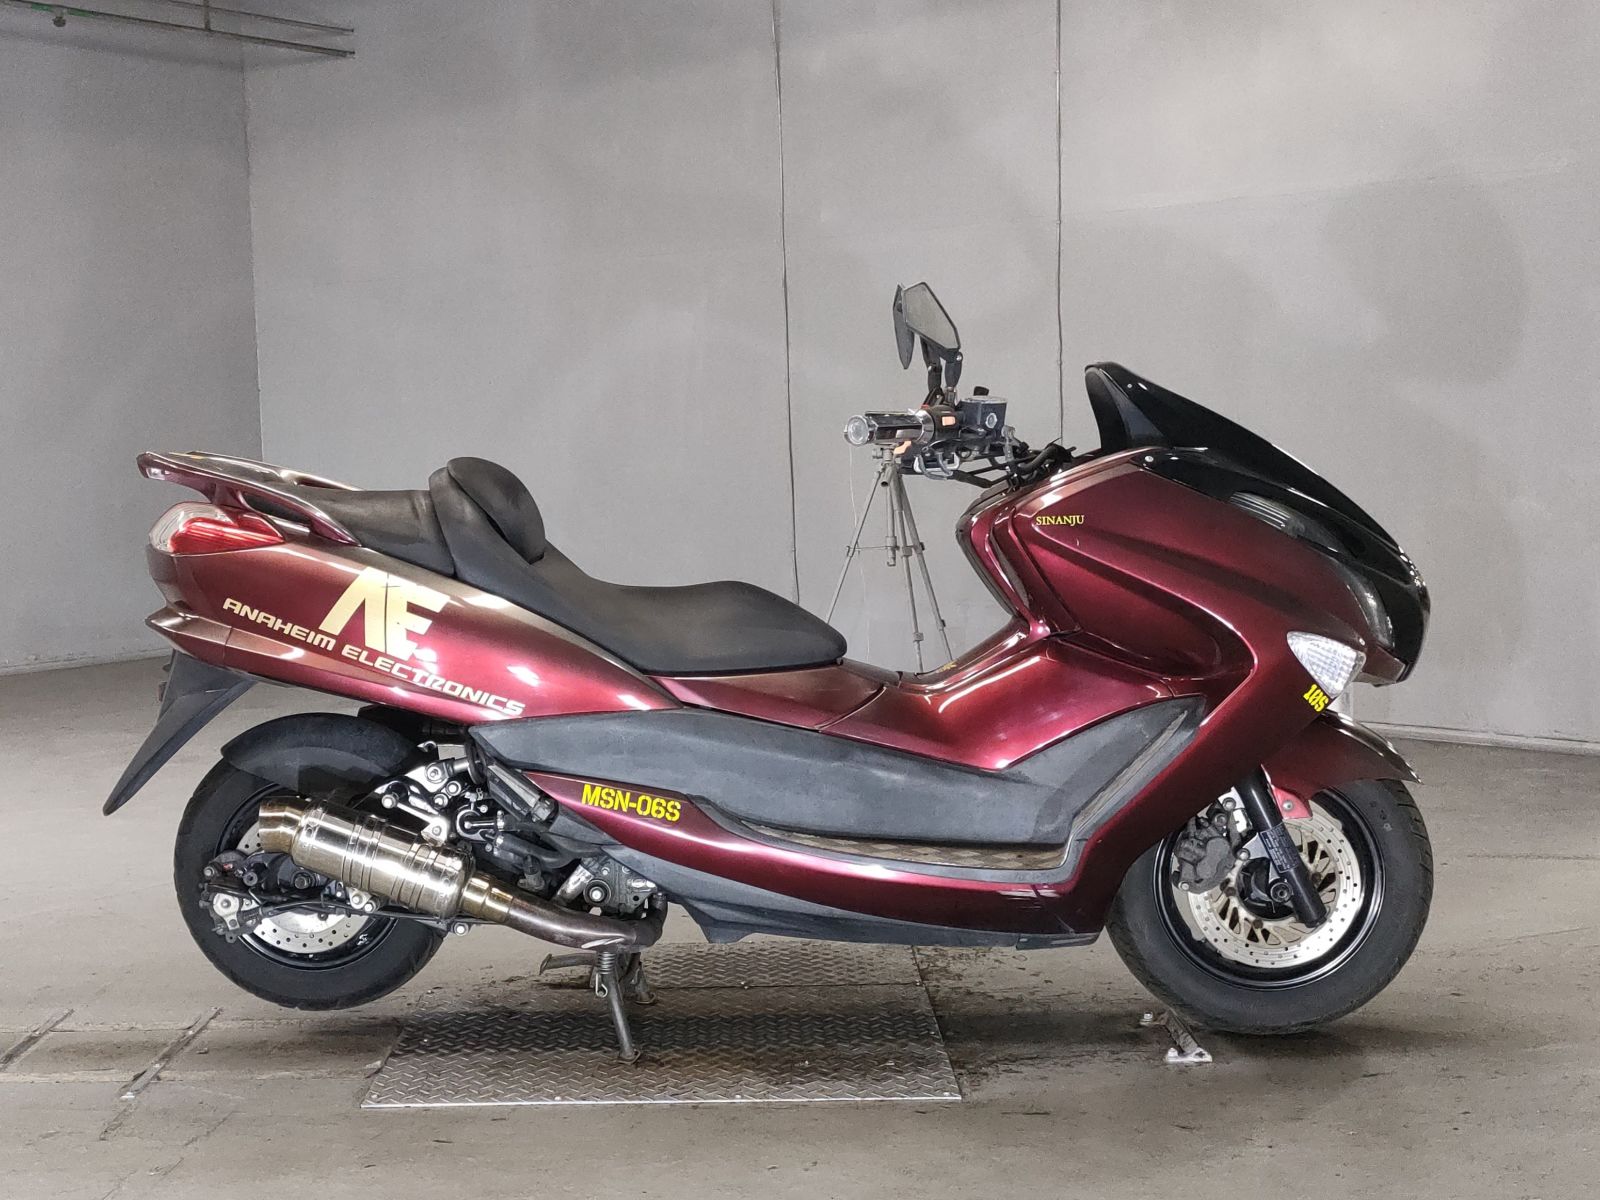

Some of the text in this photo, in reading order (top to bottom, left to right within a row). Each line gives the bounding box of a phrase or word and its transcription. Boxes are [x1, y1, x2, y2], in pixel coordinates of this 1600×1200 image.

[1035, 514, 1085, 527] SINANJU
[222, 597, 526, 715] ANAHEIM ELECTRONICS
[581, 783, 681, 822] MSN-06S
